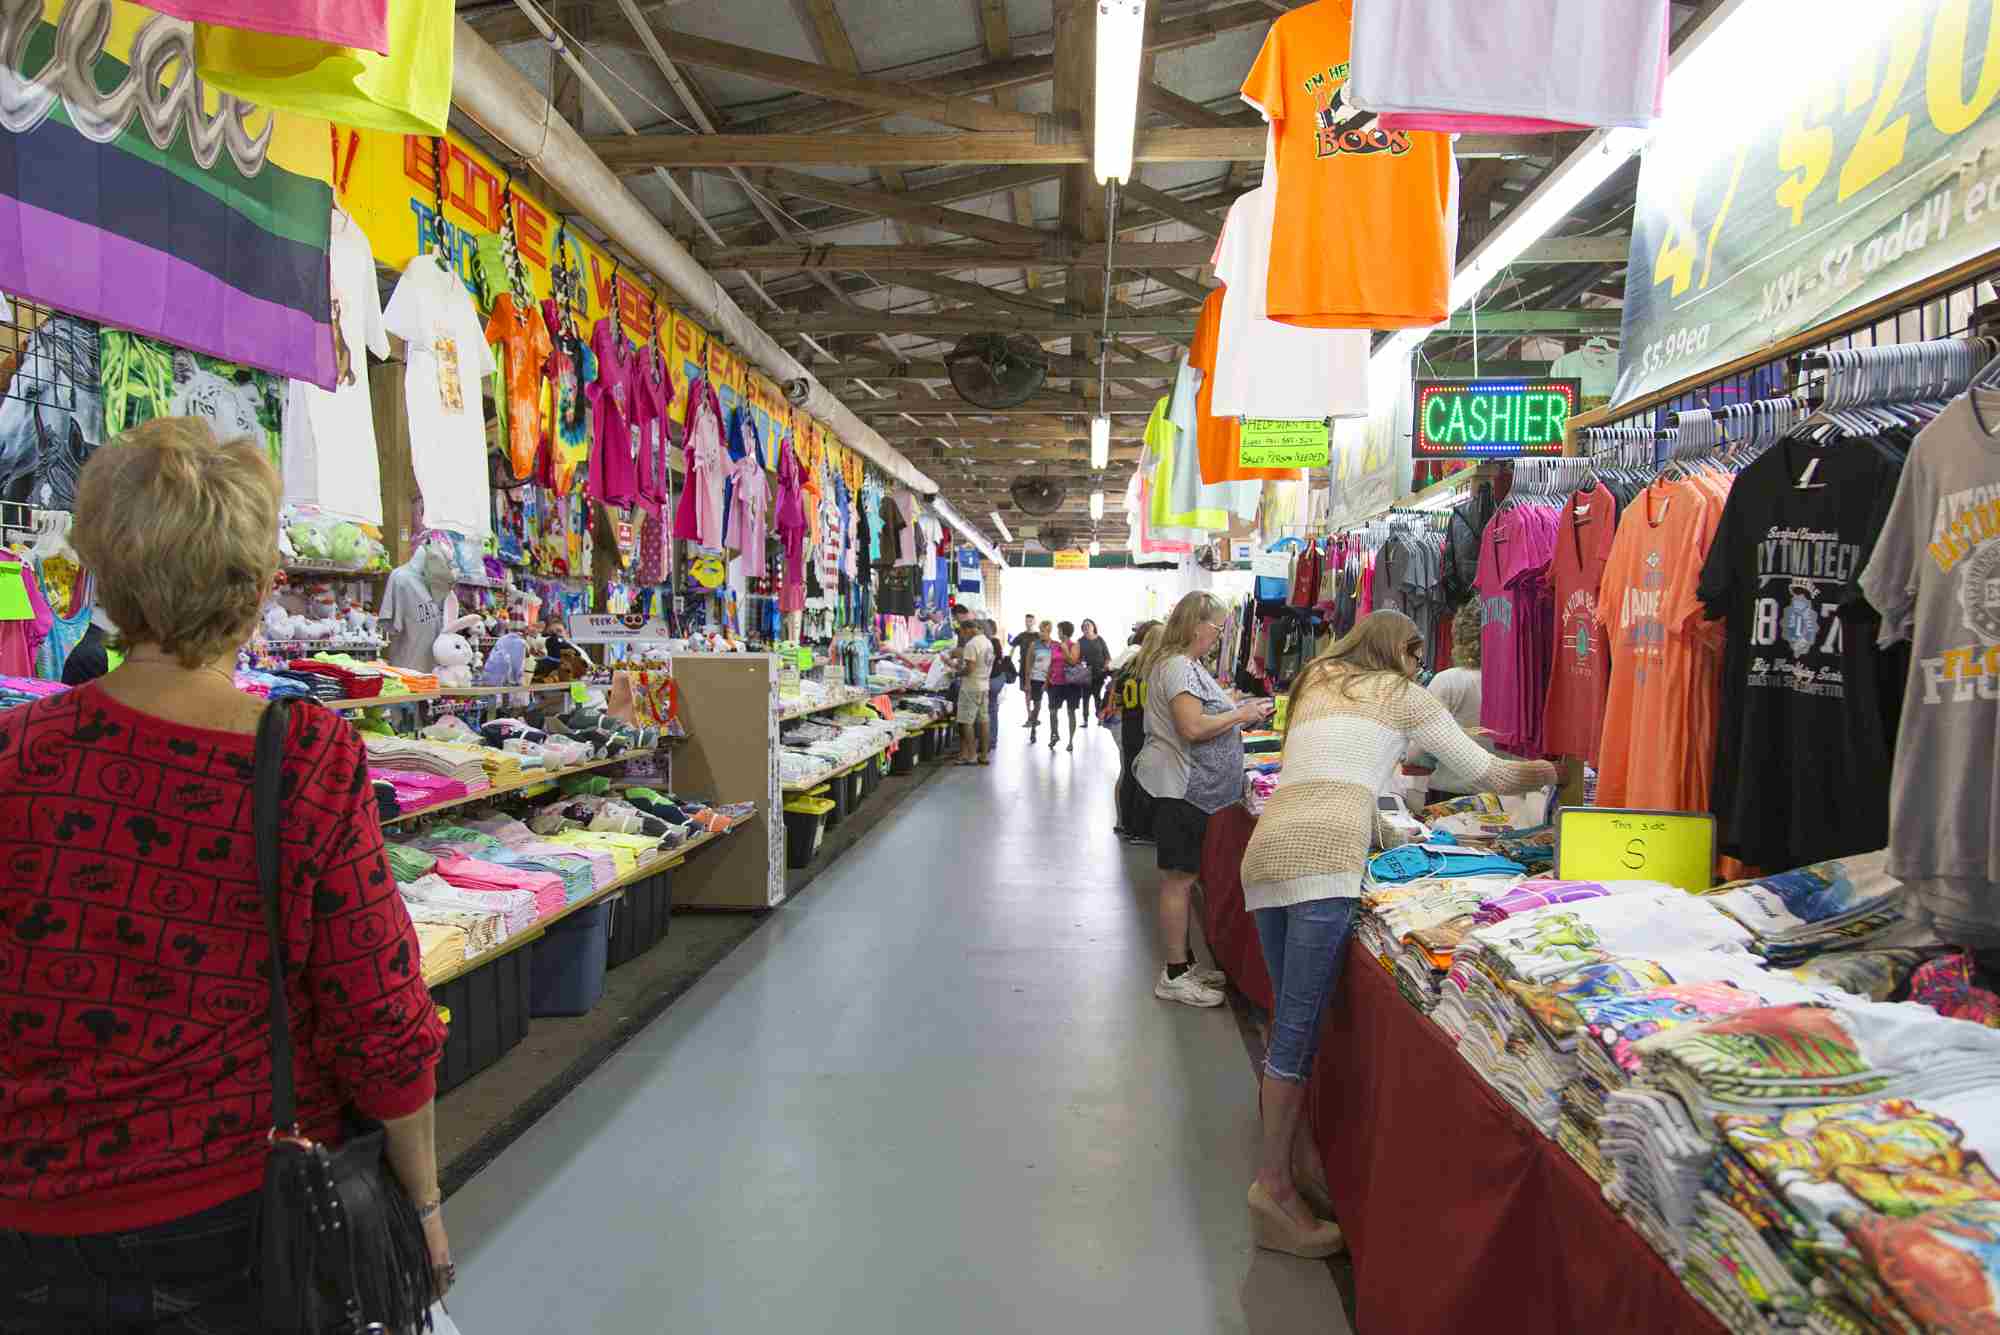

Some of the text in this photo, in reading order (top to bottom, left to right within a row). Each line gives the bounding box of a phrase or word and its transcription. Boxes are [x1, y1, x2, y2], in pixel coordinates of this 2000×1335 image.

[1315, 127, 1412, 158] BOOS
[1425, 395, 1567, 442] CASHIER
[1621, 838, 1646, 870] S
